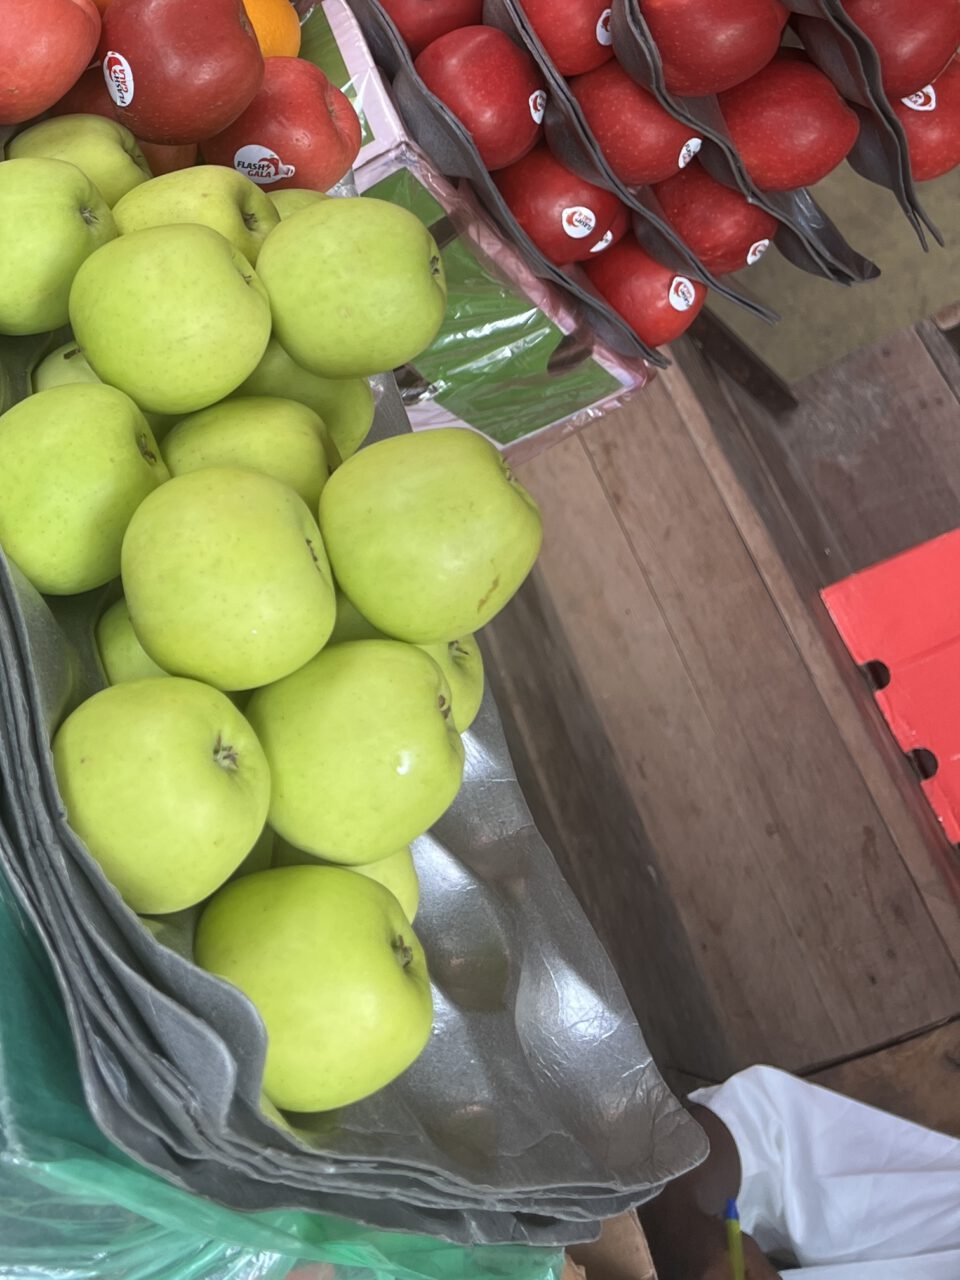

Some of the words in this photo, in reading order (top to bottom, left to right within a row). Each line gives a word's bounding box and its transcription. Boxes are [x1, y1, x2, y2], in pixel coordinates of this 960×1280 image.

[113, 73, 127, 104] FLASH
[118, 69, 129, 93] GALA
[236, 160, 265, 171] FLASH
[247, 170, 271, 178] GALA
